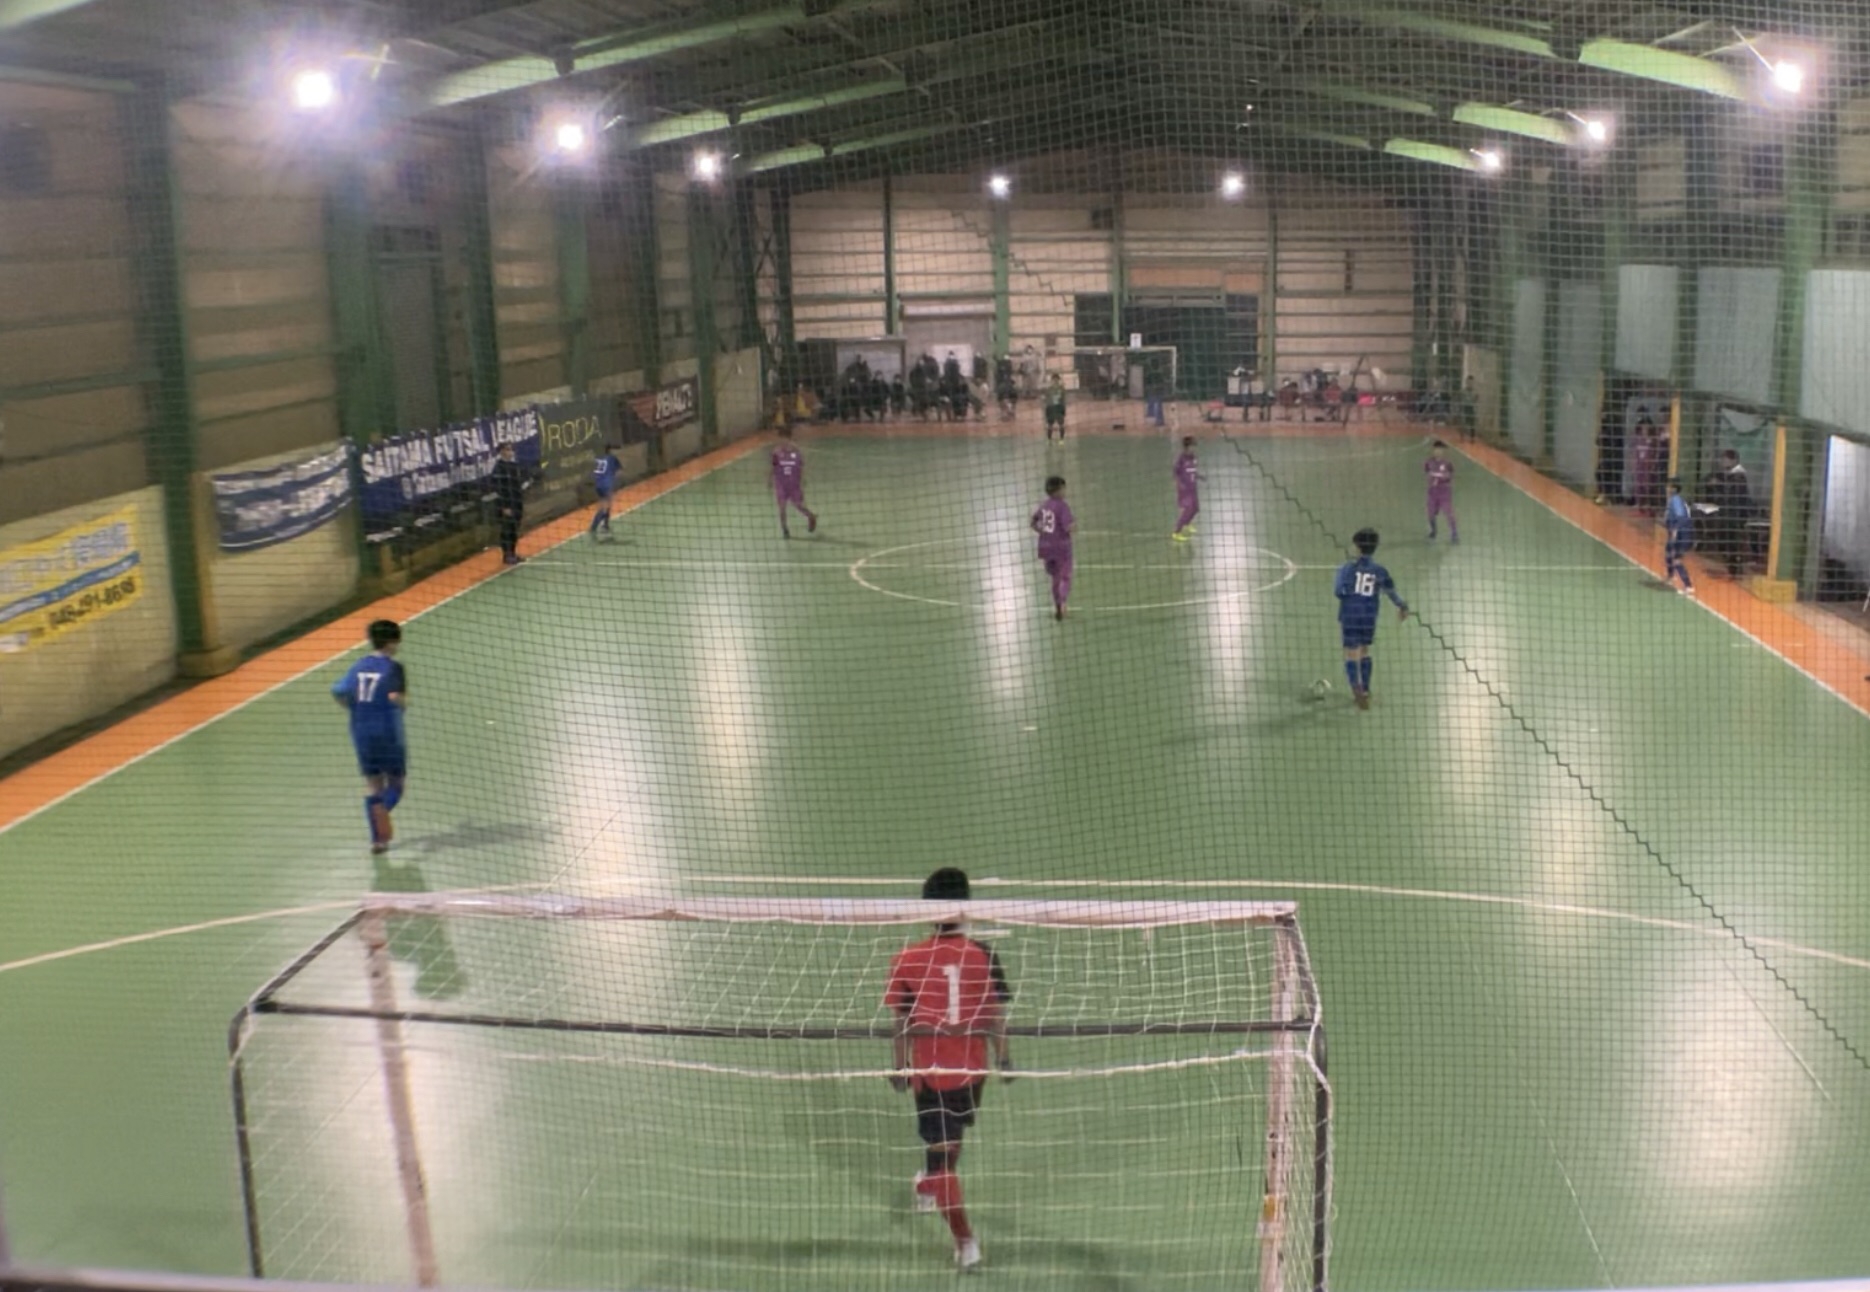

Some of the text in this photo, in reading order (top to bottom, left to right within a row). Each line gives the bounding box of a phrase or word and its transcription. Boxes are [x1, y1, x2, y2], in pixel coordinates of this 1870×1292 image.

[361, 438, 433, 484] SAITAMA
[434, 427, 490, 464] FUTSAL
[491, 411, 538, 448] LEAGUE
[357, 671, 381, 702] 17
[943, 965, 961, 1025] 1
